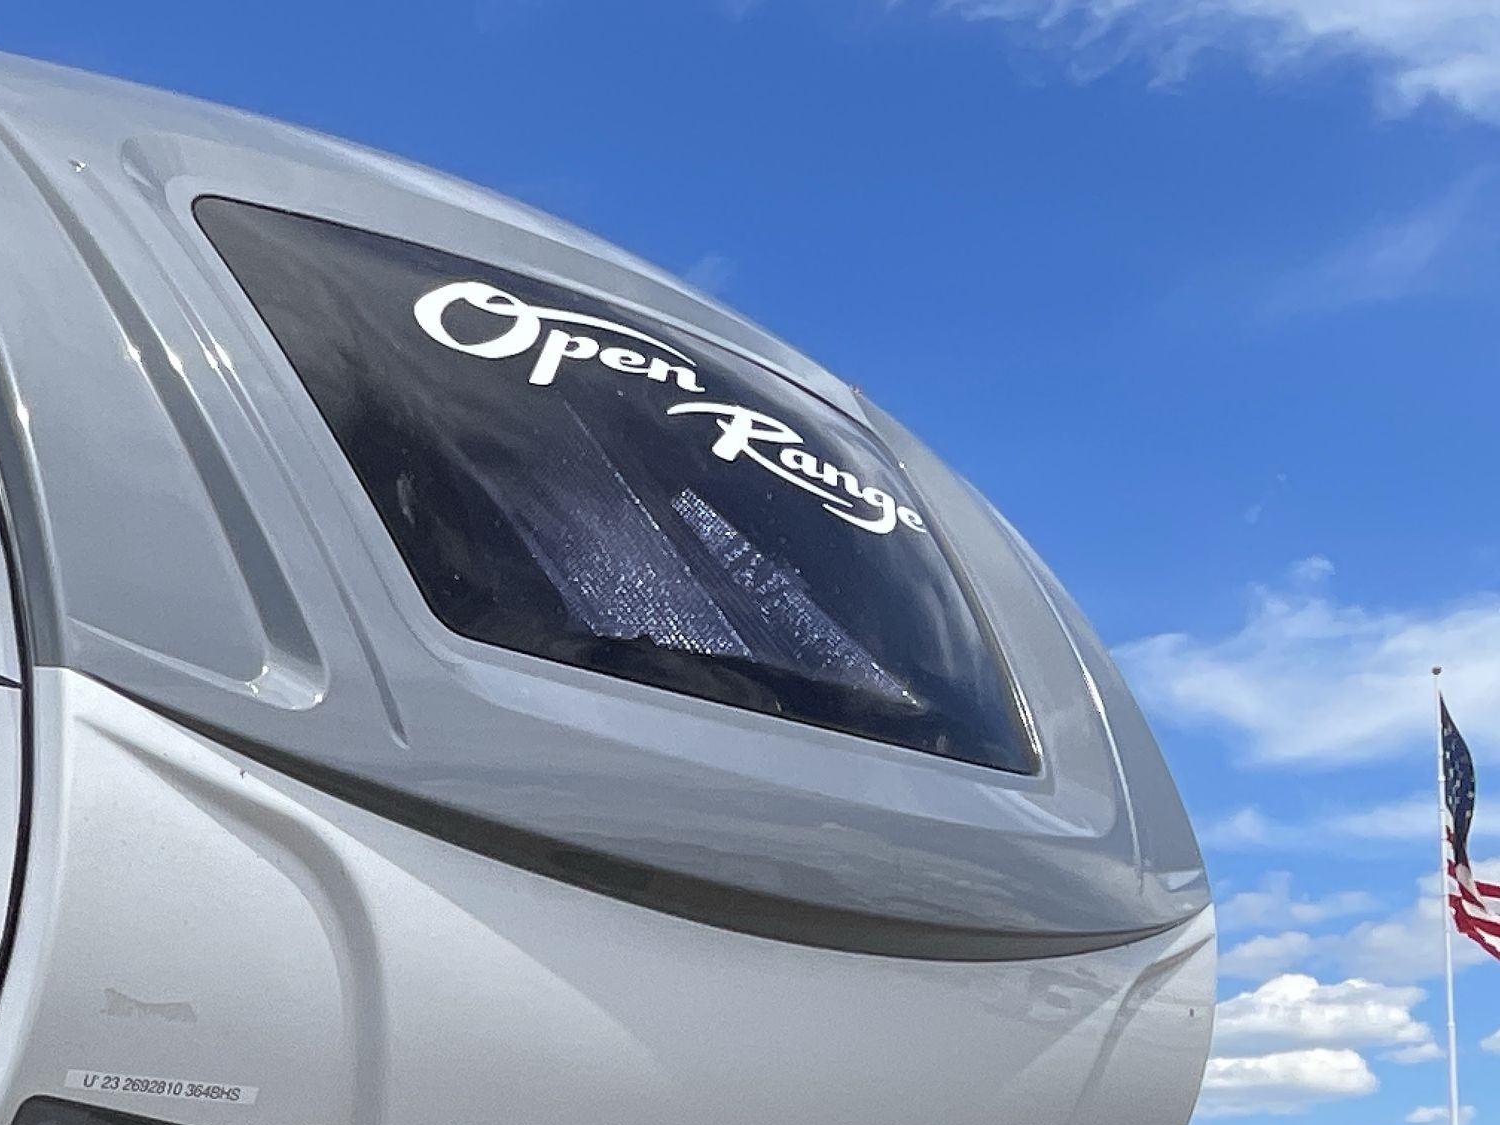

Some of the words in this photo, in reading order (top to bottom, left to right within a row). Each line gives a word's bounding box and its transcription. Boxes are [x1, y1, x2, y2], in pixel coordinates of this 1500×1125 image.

[414, 282, 705, 391] Open
[667, 402, 928, 535] Range
[101, 1076, 120, 1090] 23
[122, 1077, 182, 1096] 2692810
